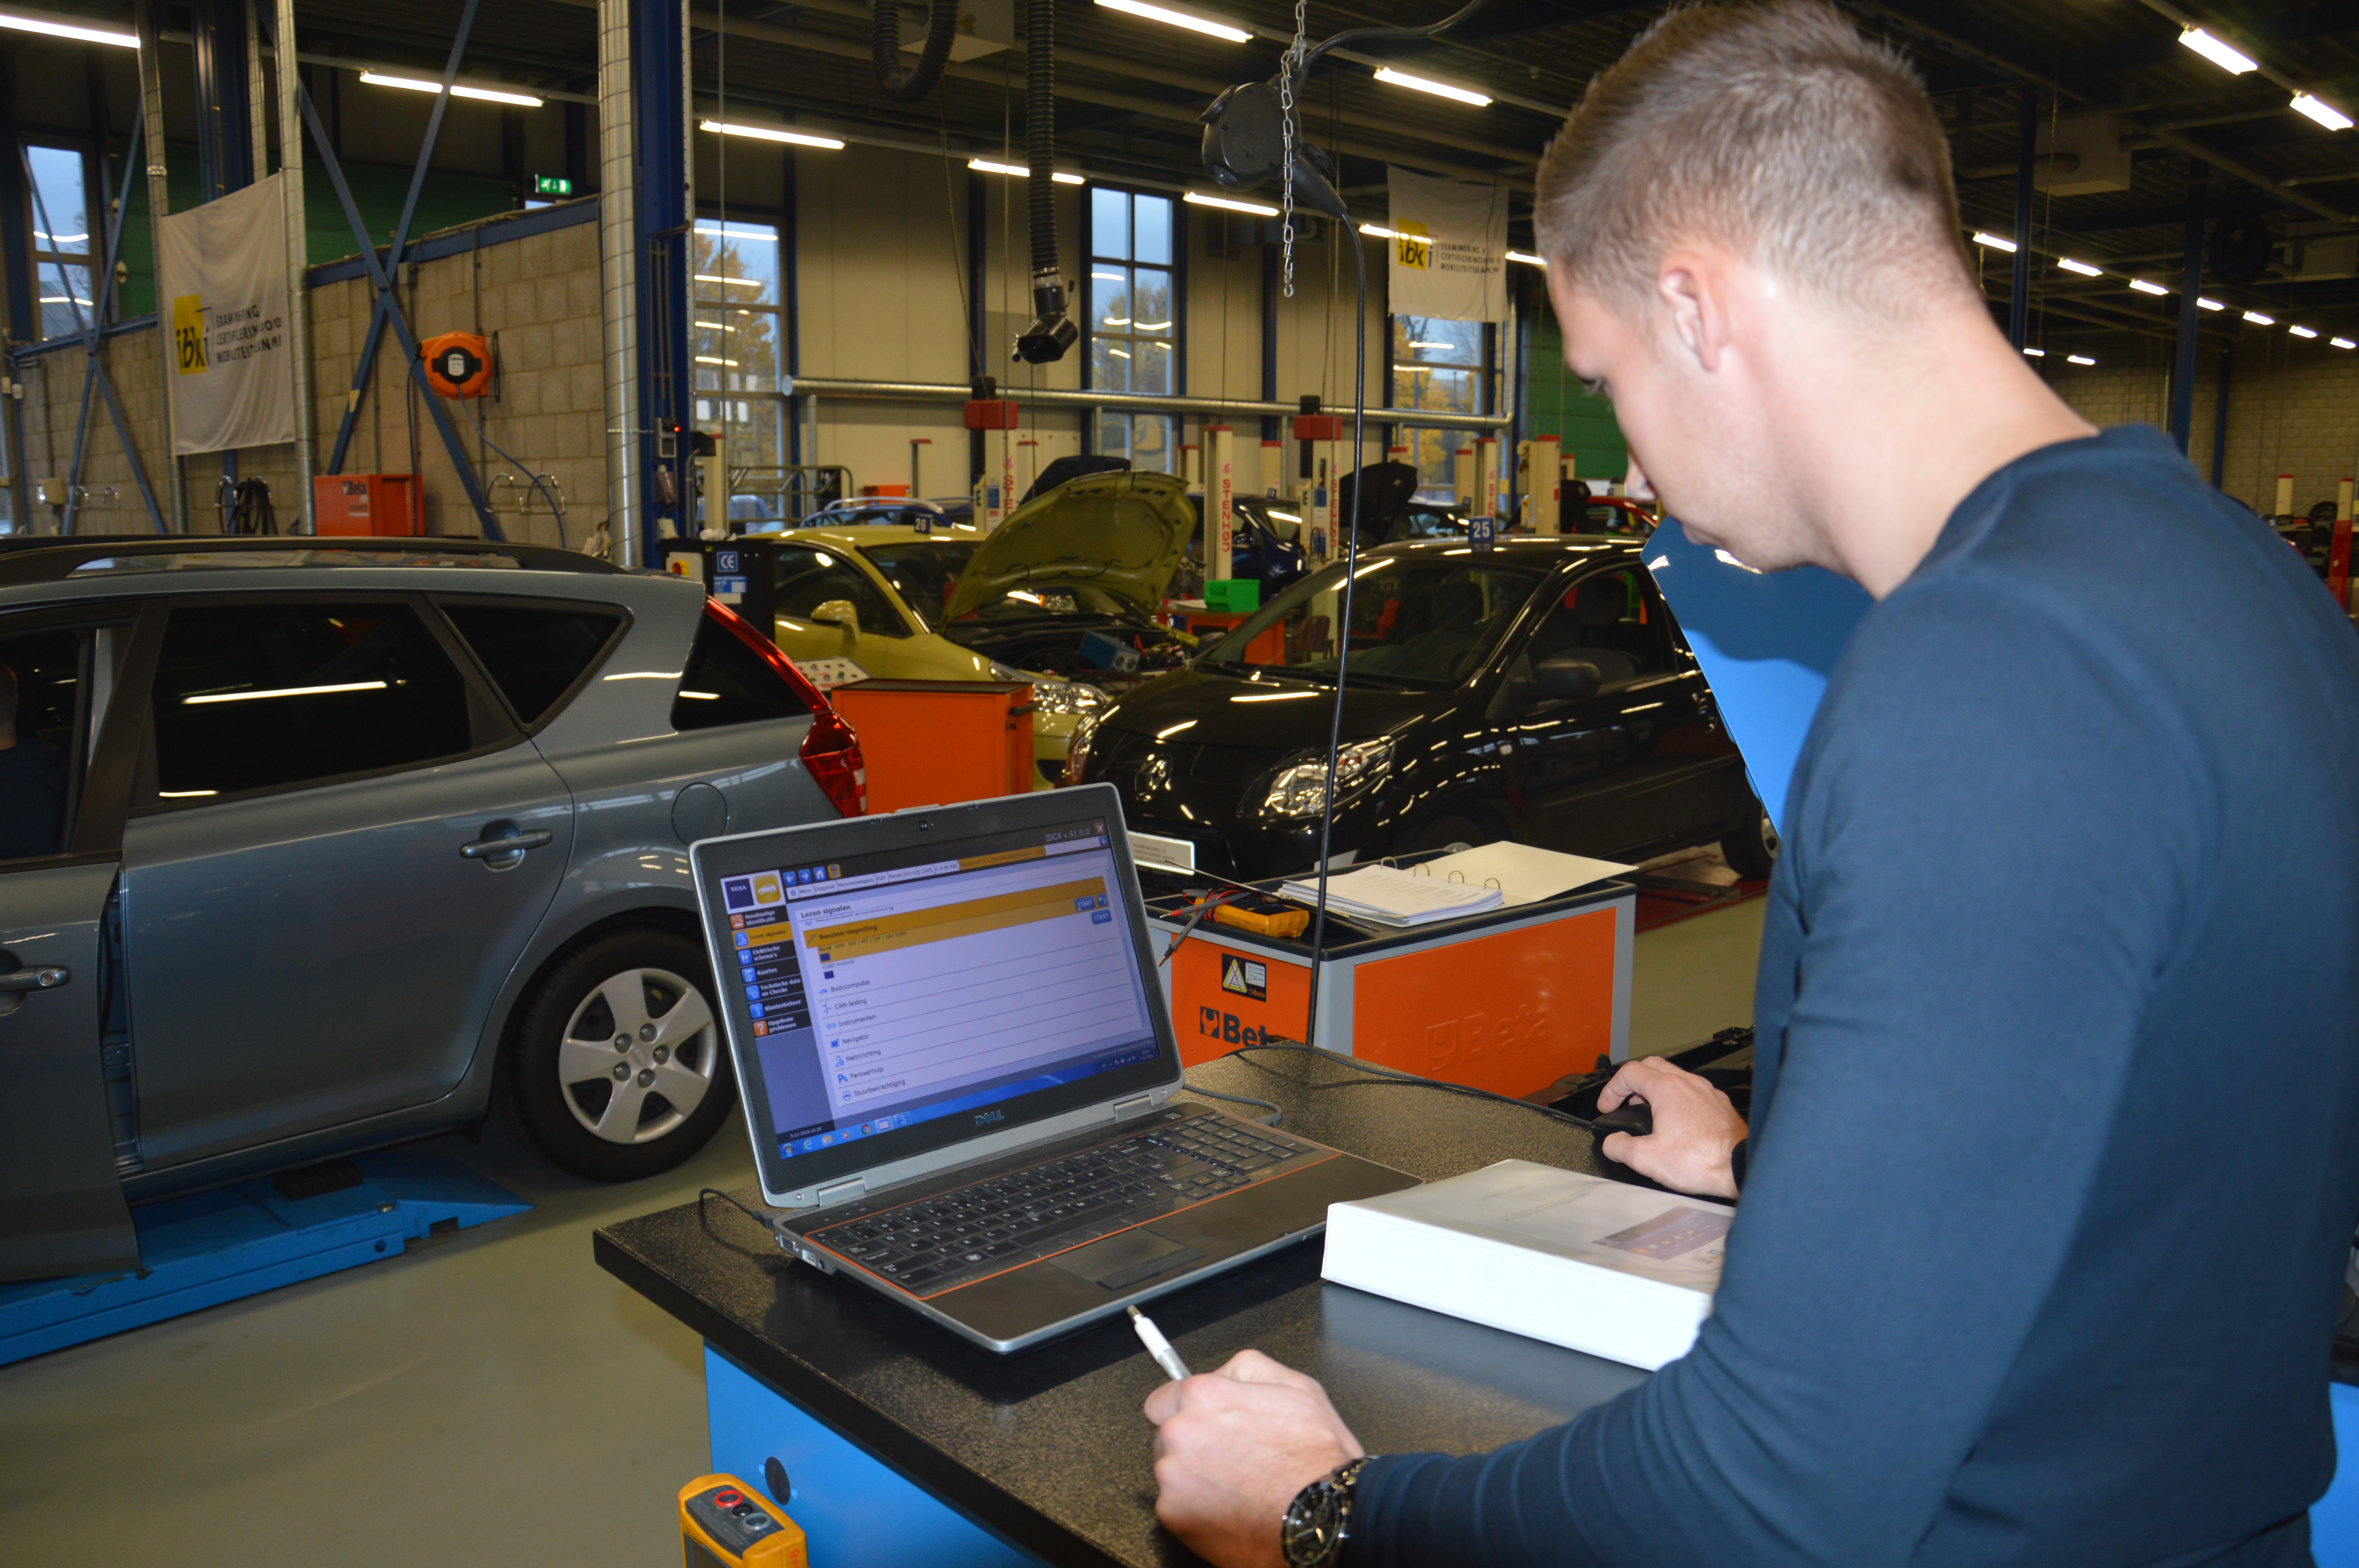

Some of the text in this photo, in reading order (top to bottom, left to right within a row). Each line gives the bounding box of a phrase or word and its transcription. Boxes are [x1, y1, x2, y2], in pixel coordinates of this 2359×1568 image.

[1473, 521, 1490, 538] 25
[745, 909, 775, 920] Handmatige
[801, 910, 821, 919] Lezen
[822, 904, 851, 916] signalen
[1093, 913, 1109, 922] START
[819, 924, 878, 940] Benzine-inspuiting
[752, 945, 780, 955] Elektrische
[754, 951, 778, 961] schema's
[757, 967, 778, 976] Kaarten
[760, 980, 789, 991] Technische
[769, 987, 788, 995] Checks
[831, 980, 871, 993] Bodycomputer
[1253, 988, 1265, 998] Beta
[765, 999, 801, 1012] Klantenbeheer
[834, 998, 867, 1009] CAN-leiding
[838, 1014, 876, 1027] Instrumenten
[769, 1022, 797, 1034] problemen
[1223, 1012, 1268, 1047] Bet
[1463, 1004, 1553, 1062] Beta
[842, 1033, 869, 1045] Navigator
[846, 1049, 881, 1062] Netinrichting
[850, 1066, 884, 1079] Parkeerhulp
[854, 1079, 906, 1096] Stuurbekrachtiging
[975, 1109, 1004, 1127] DELL
